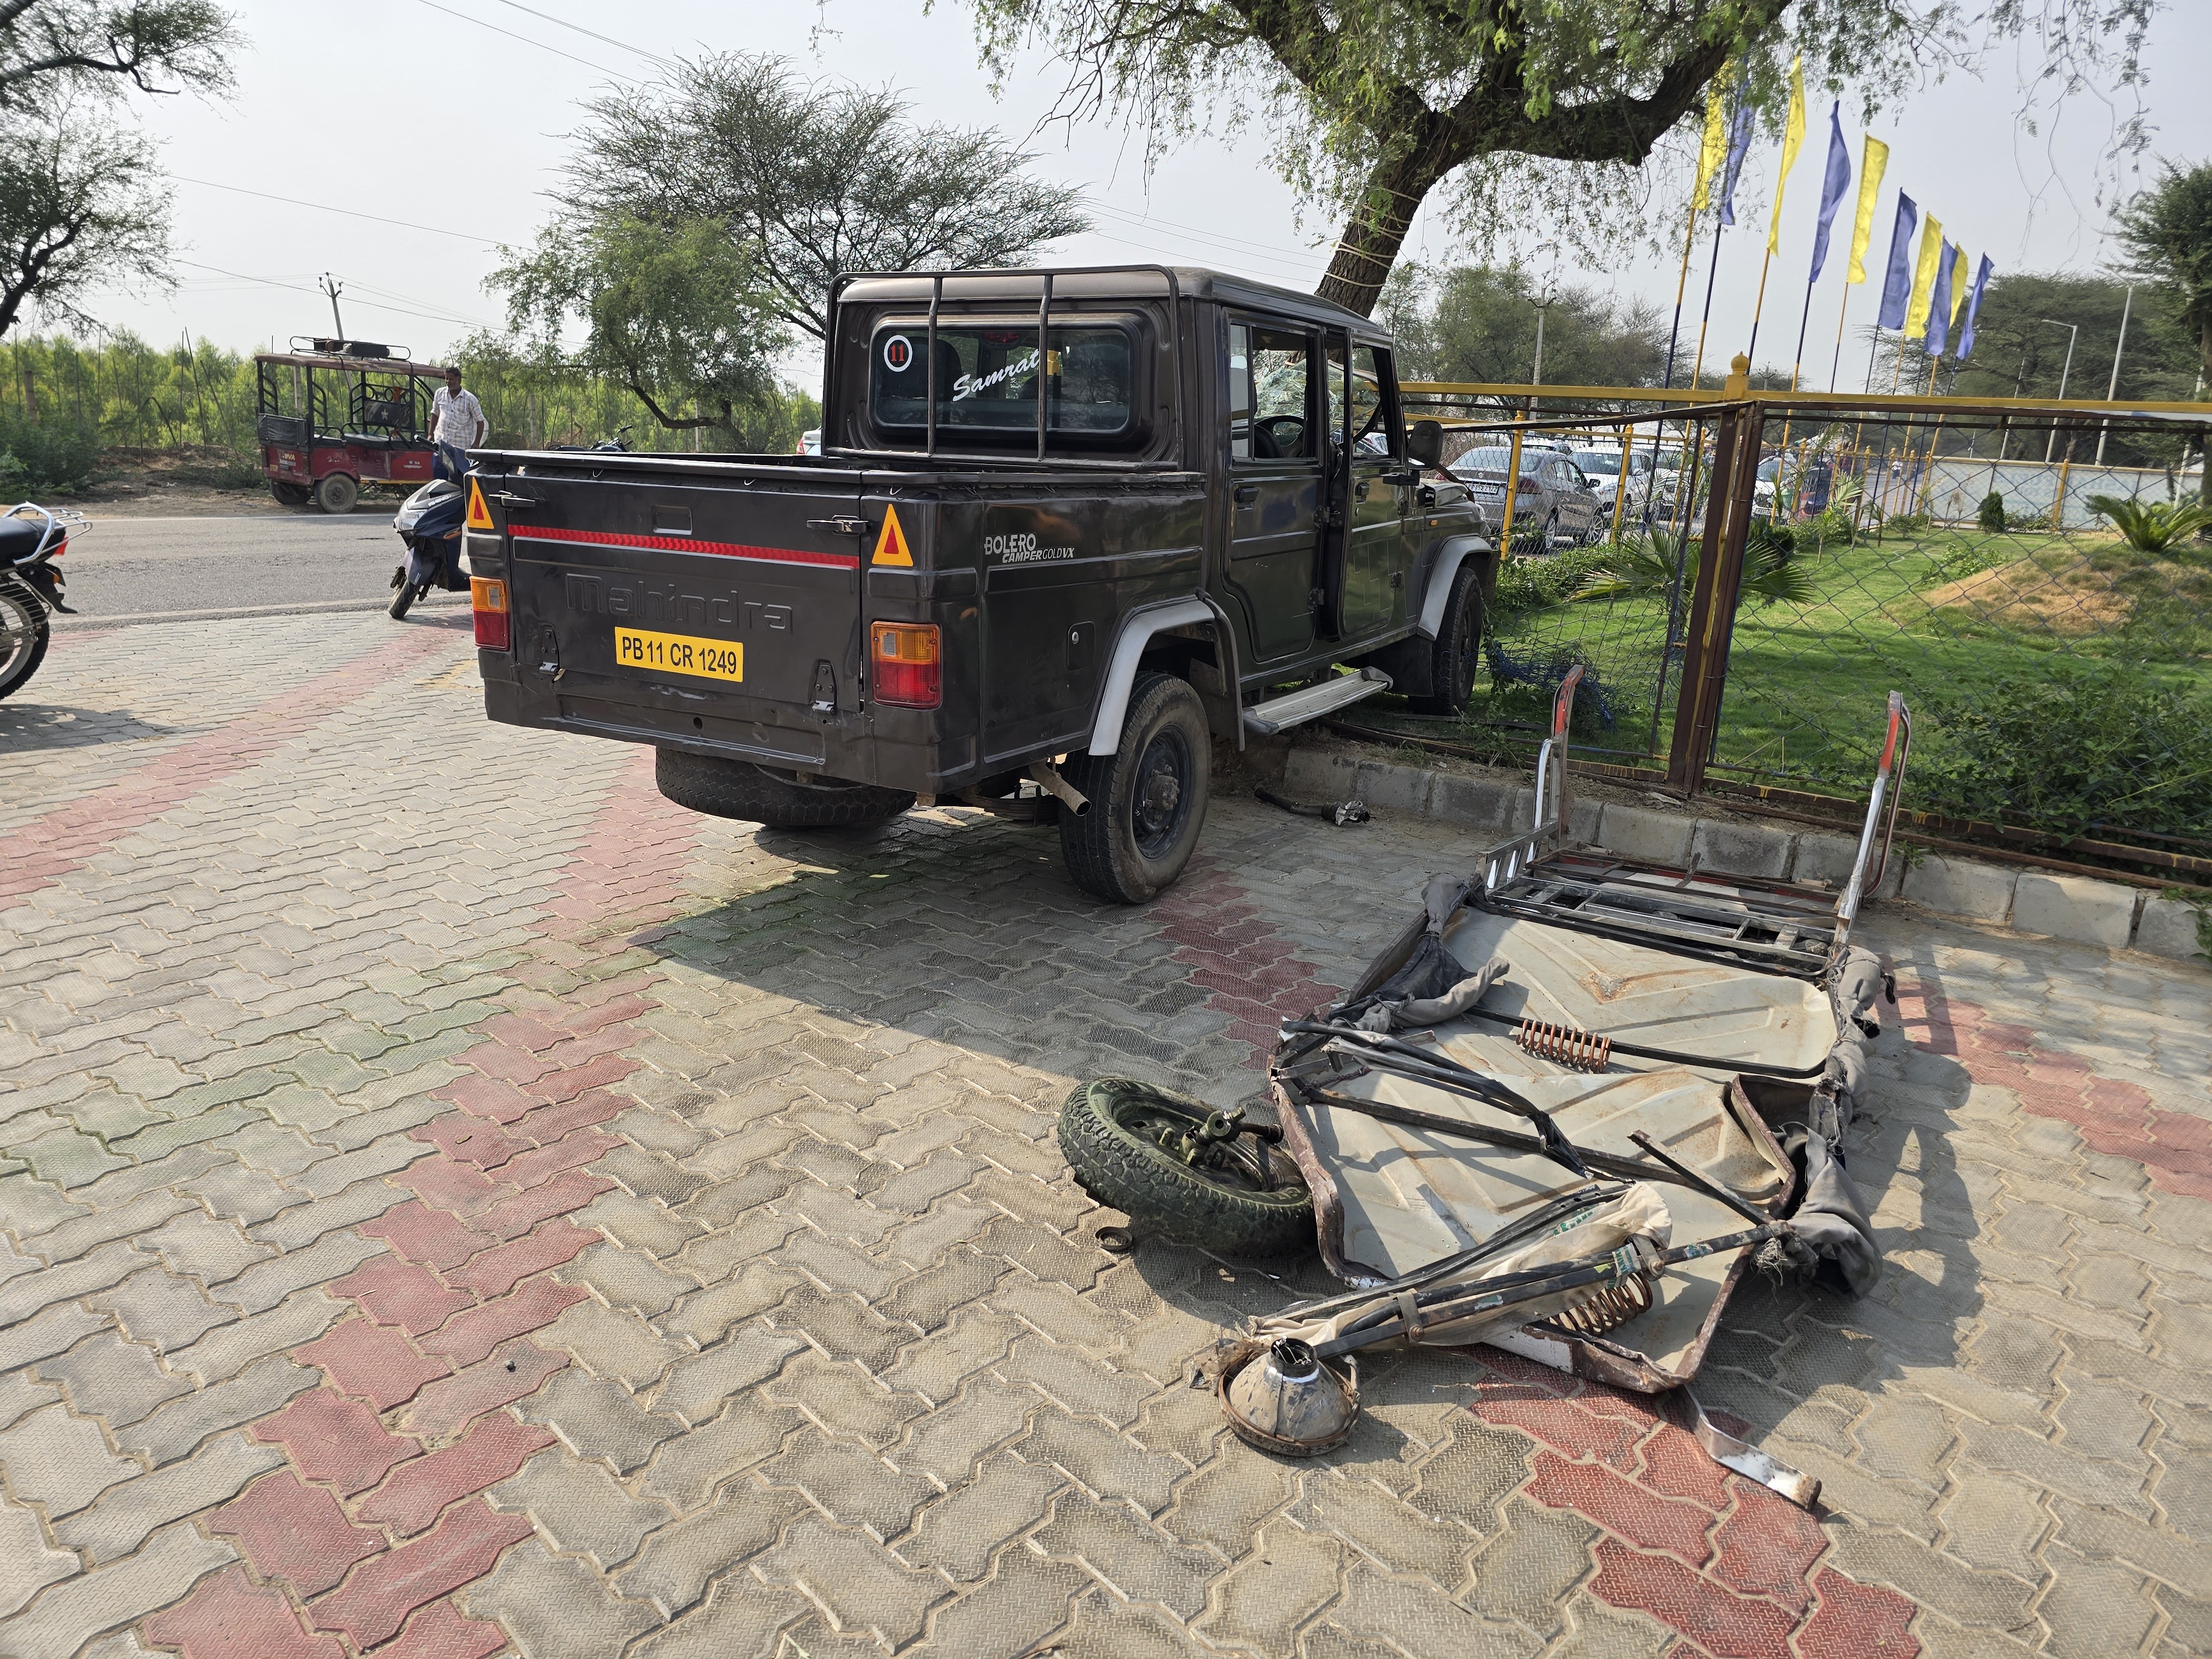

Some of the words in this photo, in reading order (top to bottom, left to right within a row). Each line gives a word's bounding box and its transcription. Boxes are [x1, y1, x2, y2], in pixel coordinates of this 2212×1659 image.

[890, 344, 905, 362] 11
[952, 348, 1040, 402] Samrat
[984, 533, 1037, 555] BOLERO
[670, 643, 693, 669] CR
[698, 648, 737, 675] 1249
